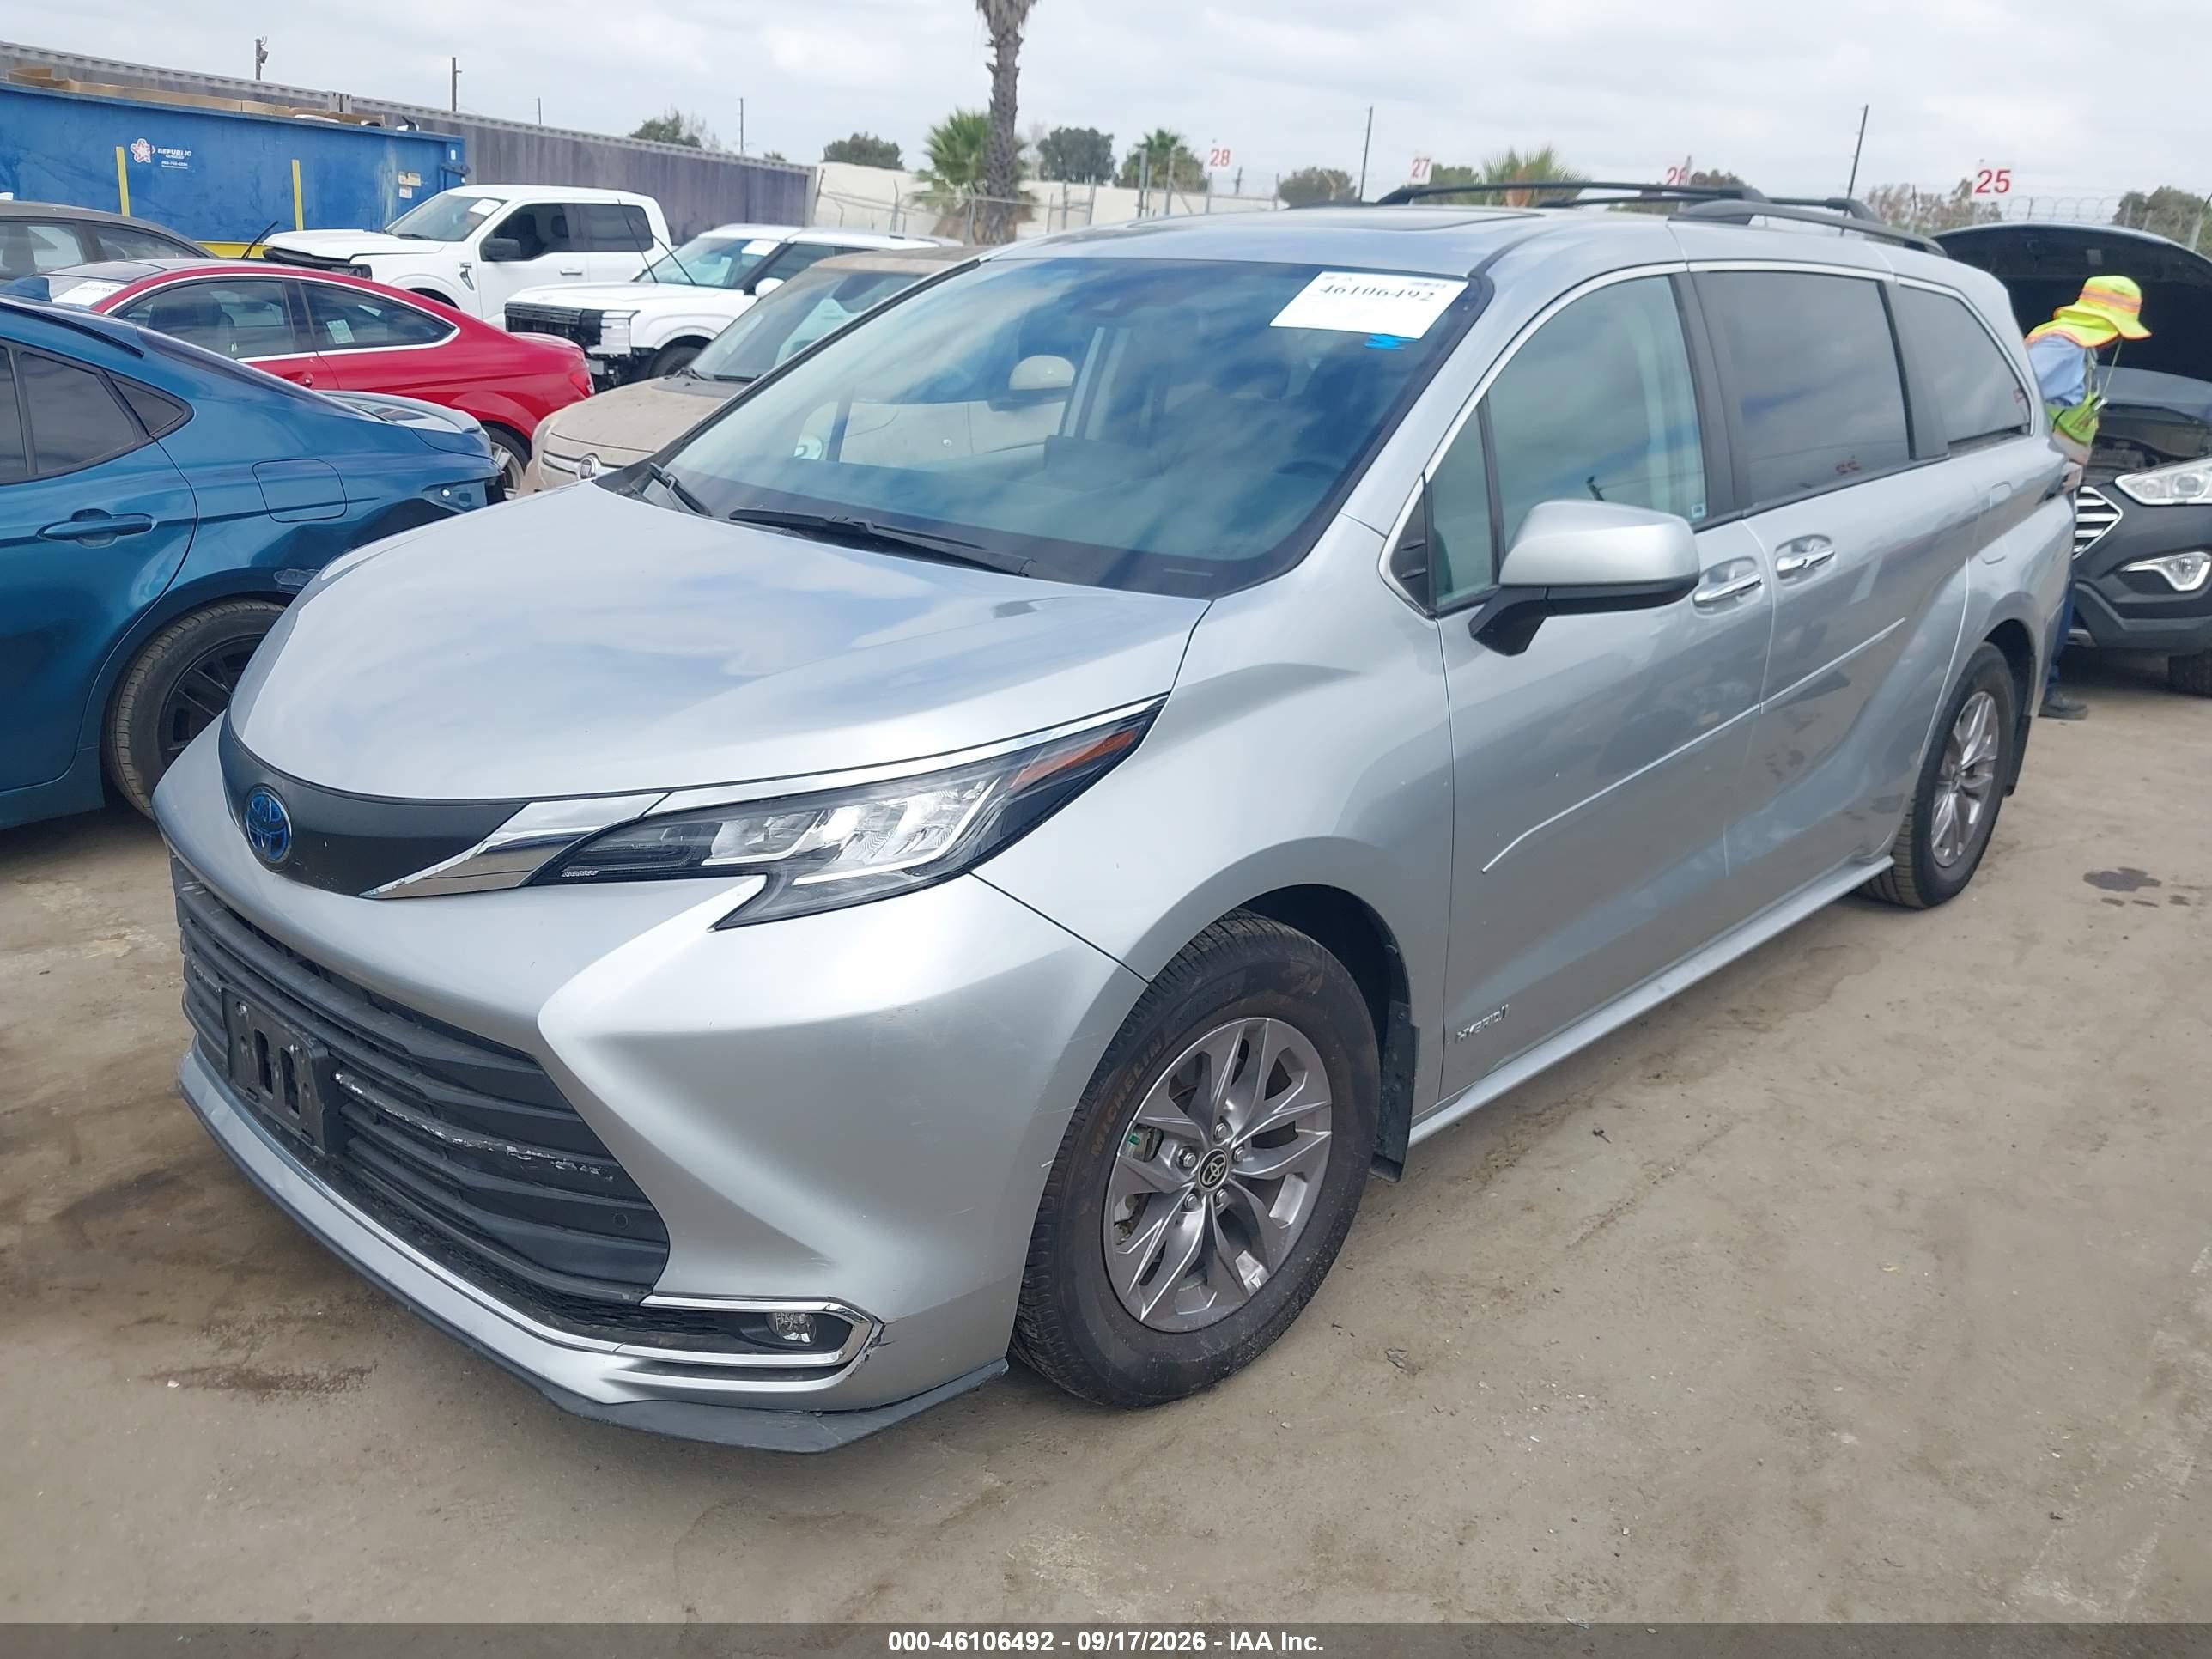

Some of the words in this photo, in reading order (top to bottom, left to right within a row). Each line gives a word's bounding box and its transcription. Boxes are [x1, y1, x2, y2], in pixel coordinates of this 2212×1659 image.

[1209, 149, 1231, 167] 28
[1411, 157, 1431, 179] 27
[1975, 169, 2011, 194] 25
[1320, 283, 1436, 302] 46106492
